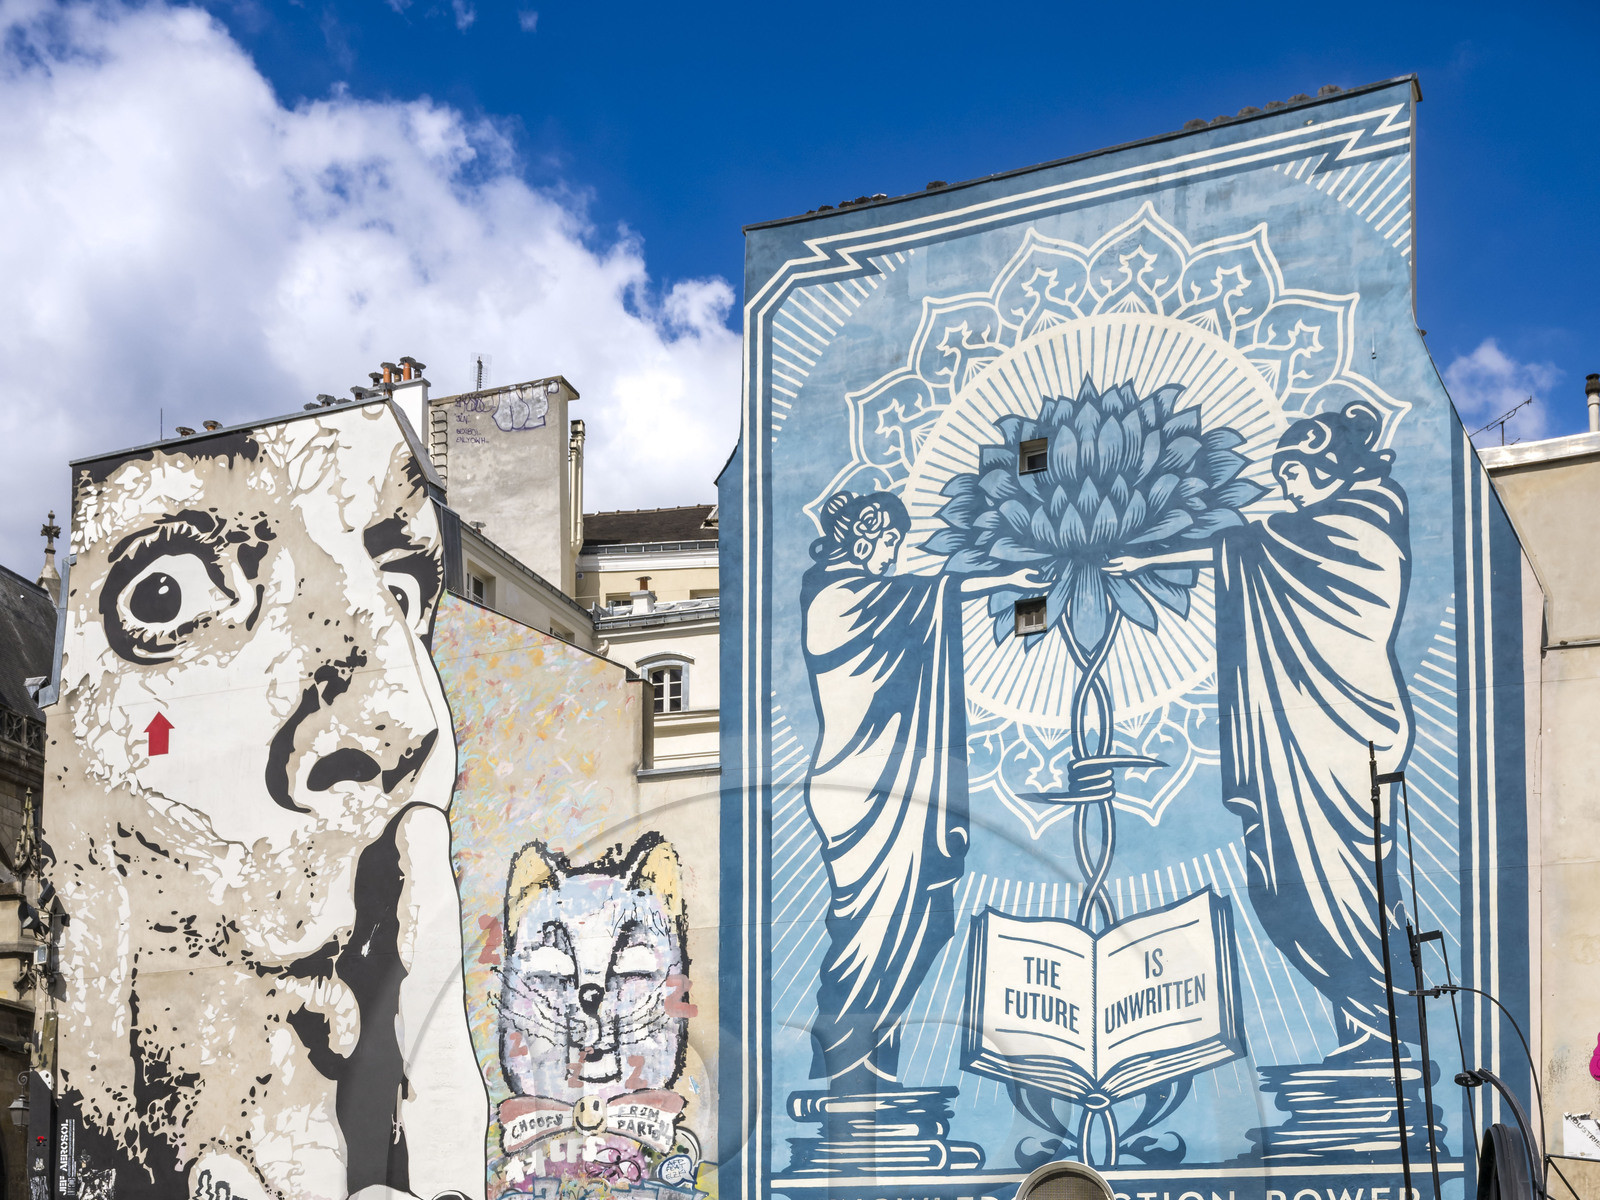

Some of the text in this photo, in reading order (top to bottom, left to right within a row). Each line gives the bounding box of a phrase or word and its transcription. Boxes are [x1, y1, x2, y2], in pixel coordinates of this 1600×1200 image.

[1023, 956, 1061, 990] THE
[1145, 948, 1164, 979] IS
[1005, 987, 1080, 1034] FUTURE
[1105, 973, 1206, 1034] UNWRITTEN
[60, 1119, 69, 1172] AEROSOL
